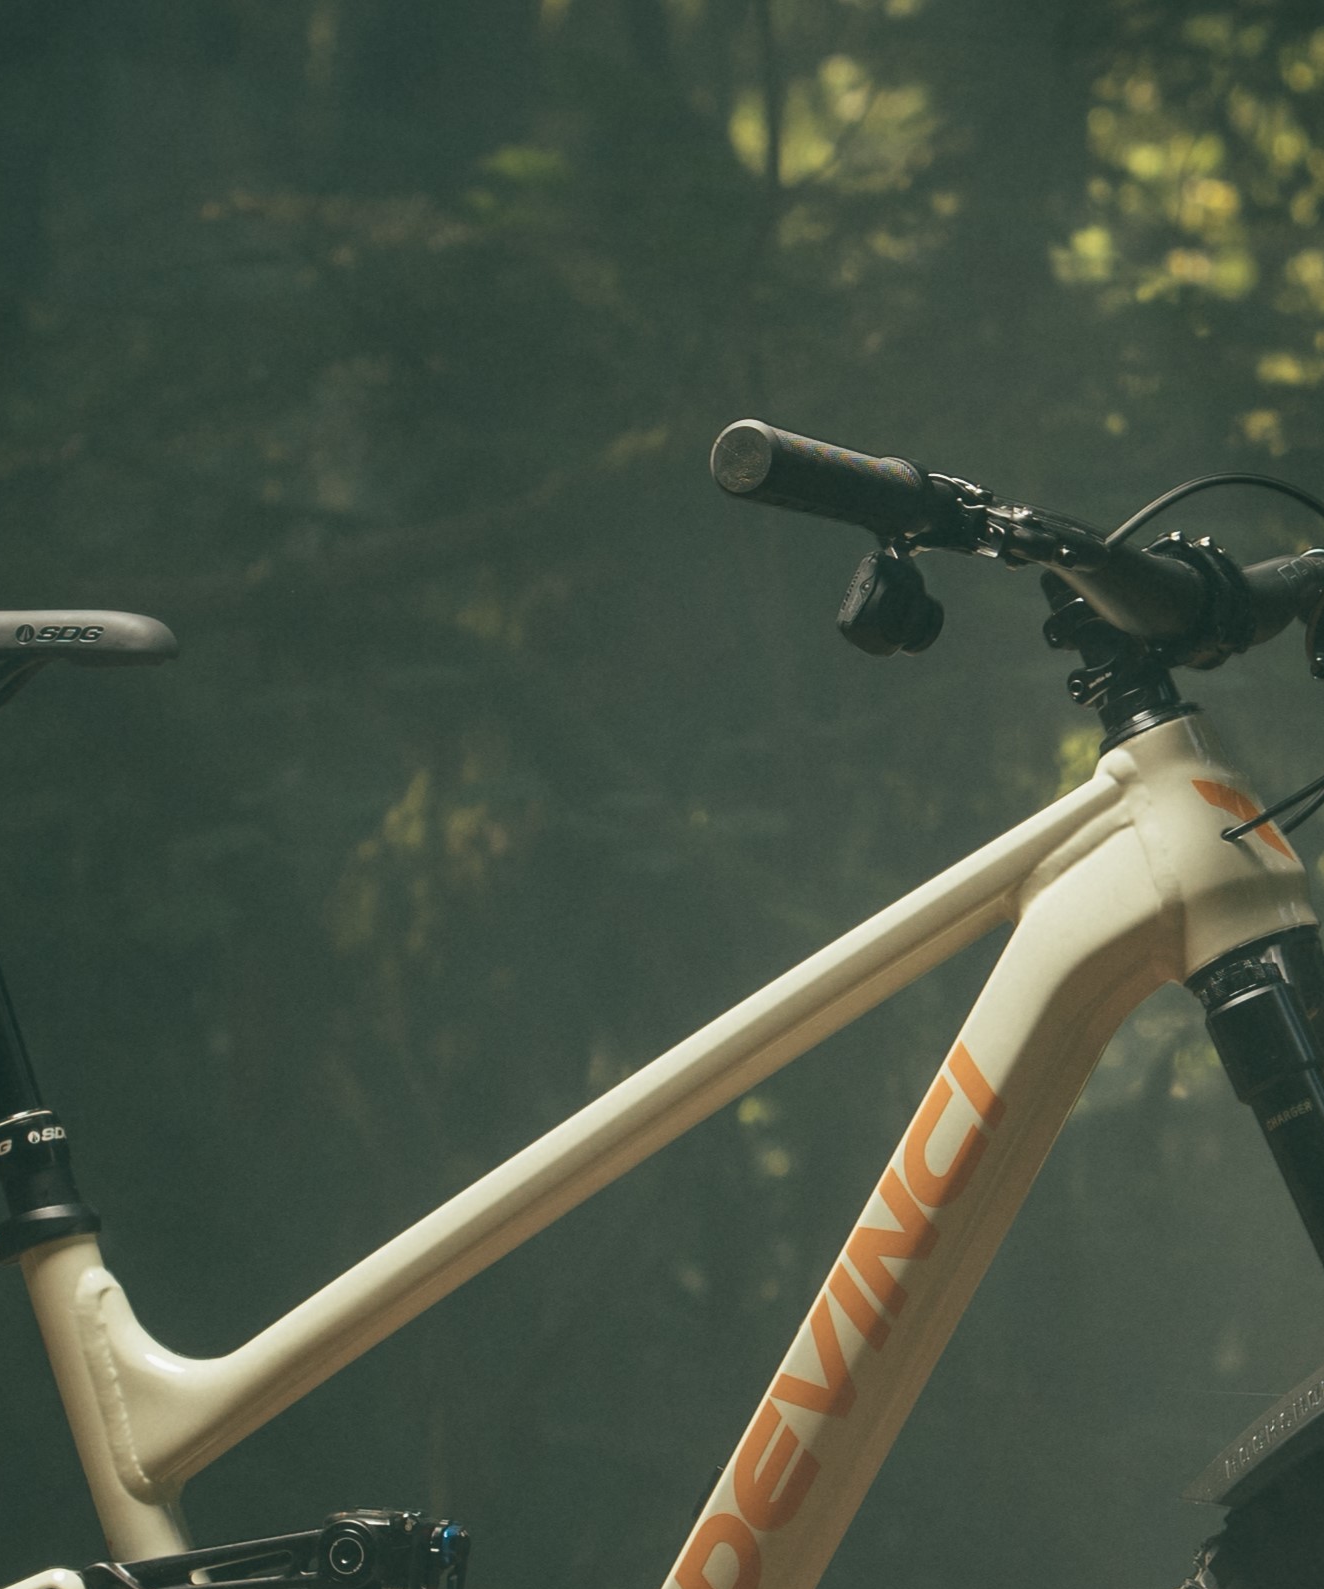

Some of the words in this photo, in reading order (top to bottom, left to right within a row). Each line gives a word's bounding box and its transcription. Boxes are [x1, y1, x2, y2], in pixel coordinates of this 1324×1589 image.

[35, 625, 105, 642] SDG
[1264, 1099, 1314, 1131] CHARGER
[42, 1126, 67, 1142] SD
